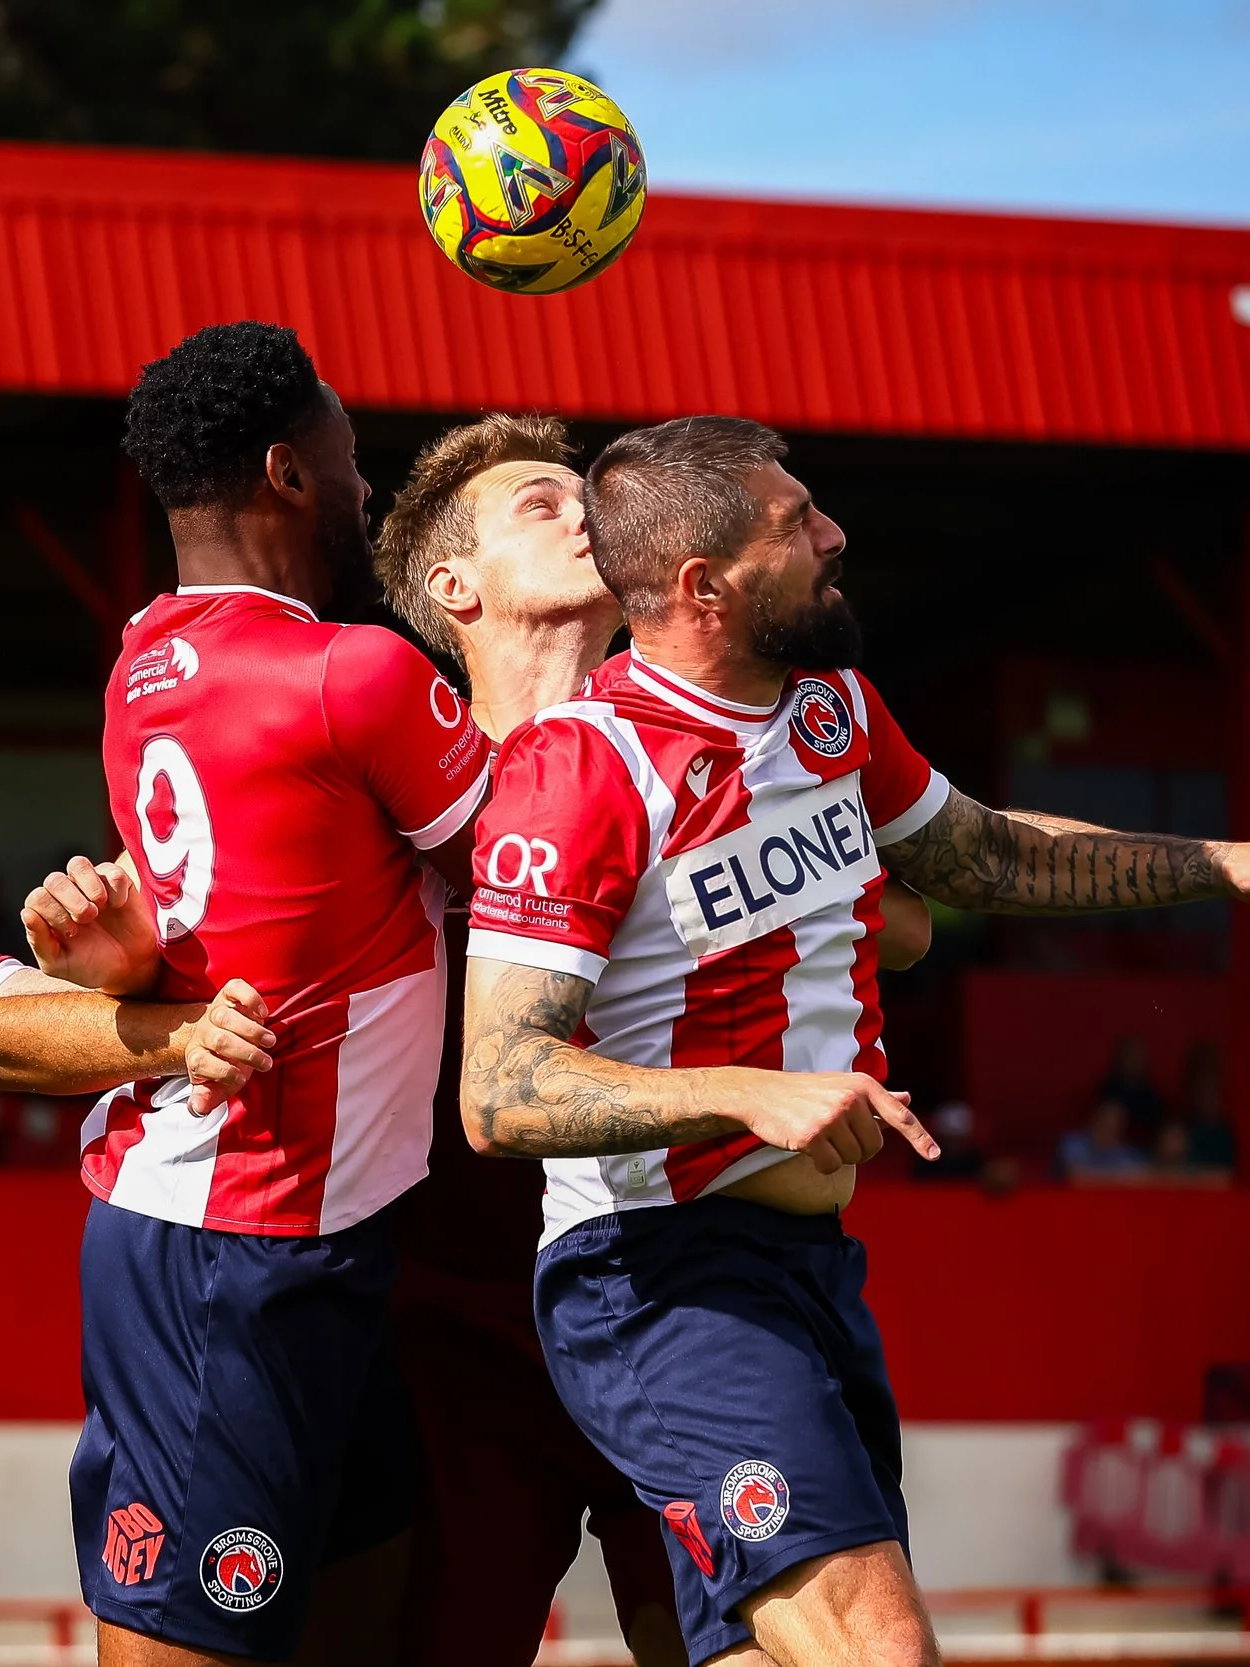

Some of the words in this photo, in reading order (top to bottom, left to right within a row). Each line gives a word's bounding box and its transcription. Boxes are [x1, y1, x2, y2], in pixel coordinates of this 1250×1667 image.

[142, 677, 178, 695] Services
[814, 726, 849, 754] SPORTING
[136, 733, 216, 946] 9
[487, 832, 559, 898] OR
[690, 791, 874, 931] ELONEX
[525, 898, 571, 915] rutter
[724, 1463, 778, 1506] BROMSGROVE
[737, 1506, 785, 1538] SPORTING
[213, 1532, 278, 1570] BROMSGROVE
[208, 1579, 262, 1608] SPORTING
